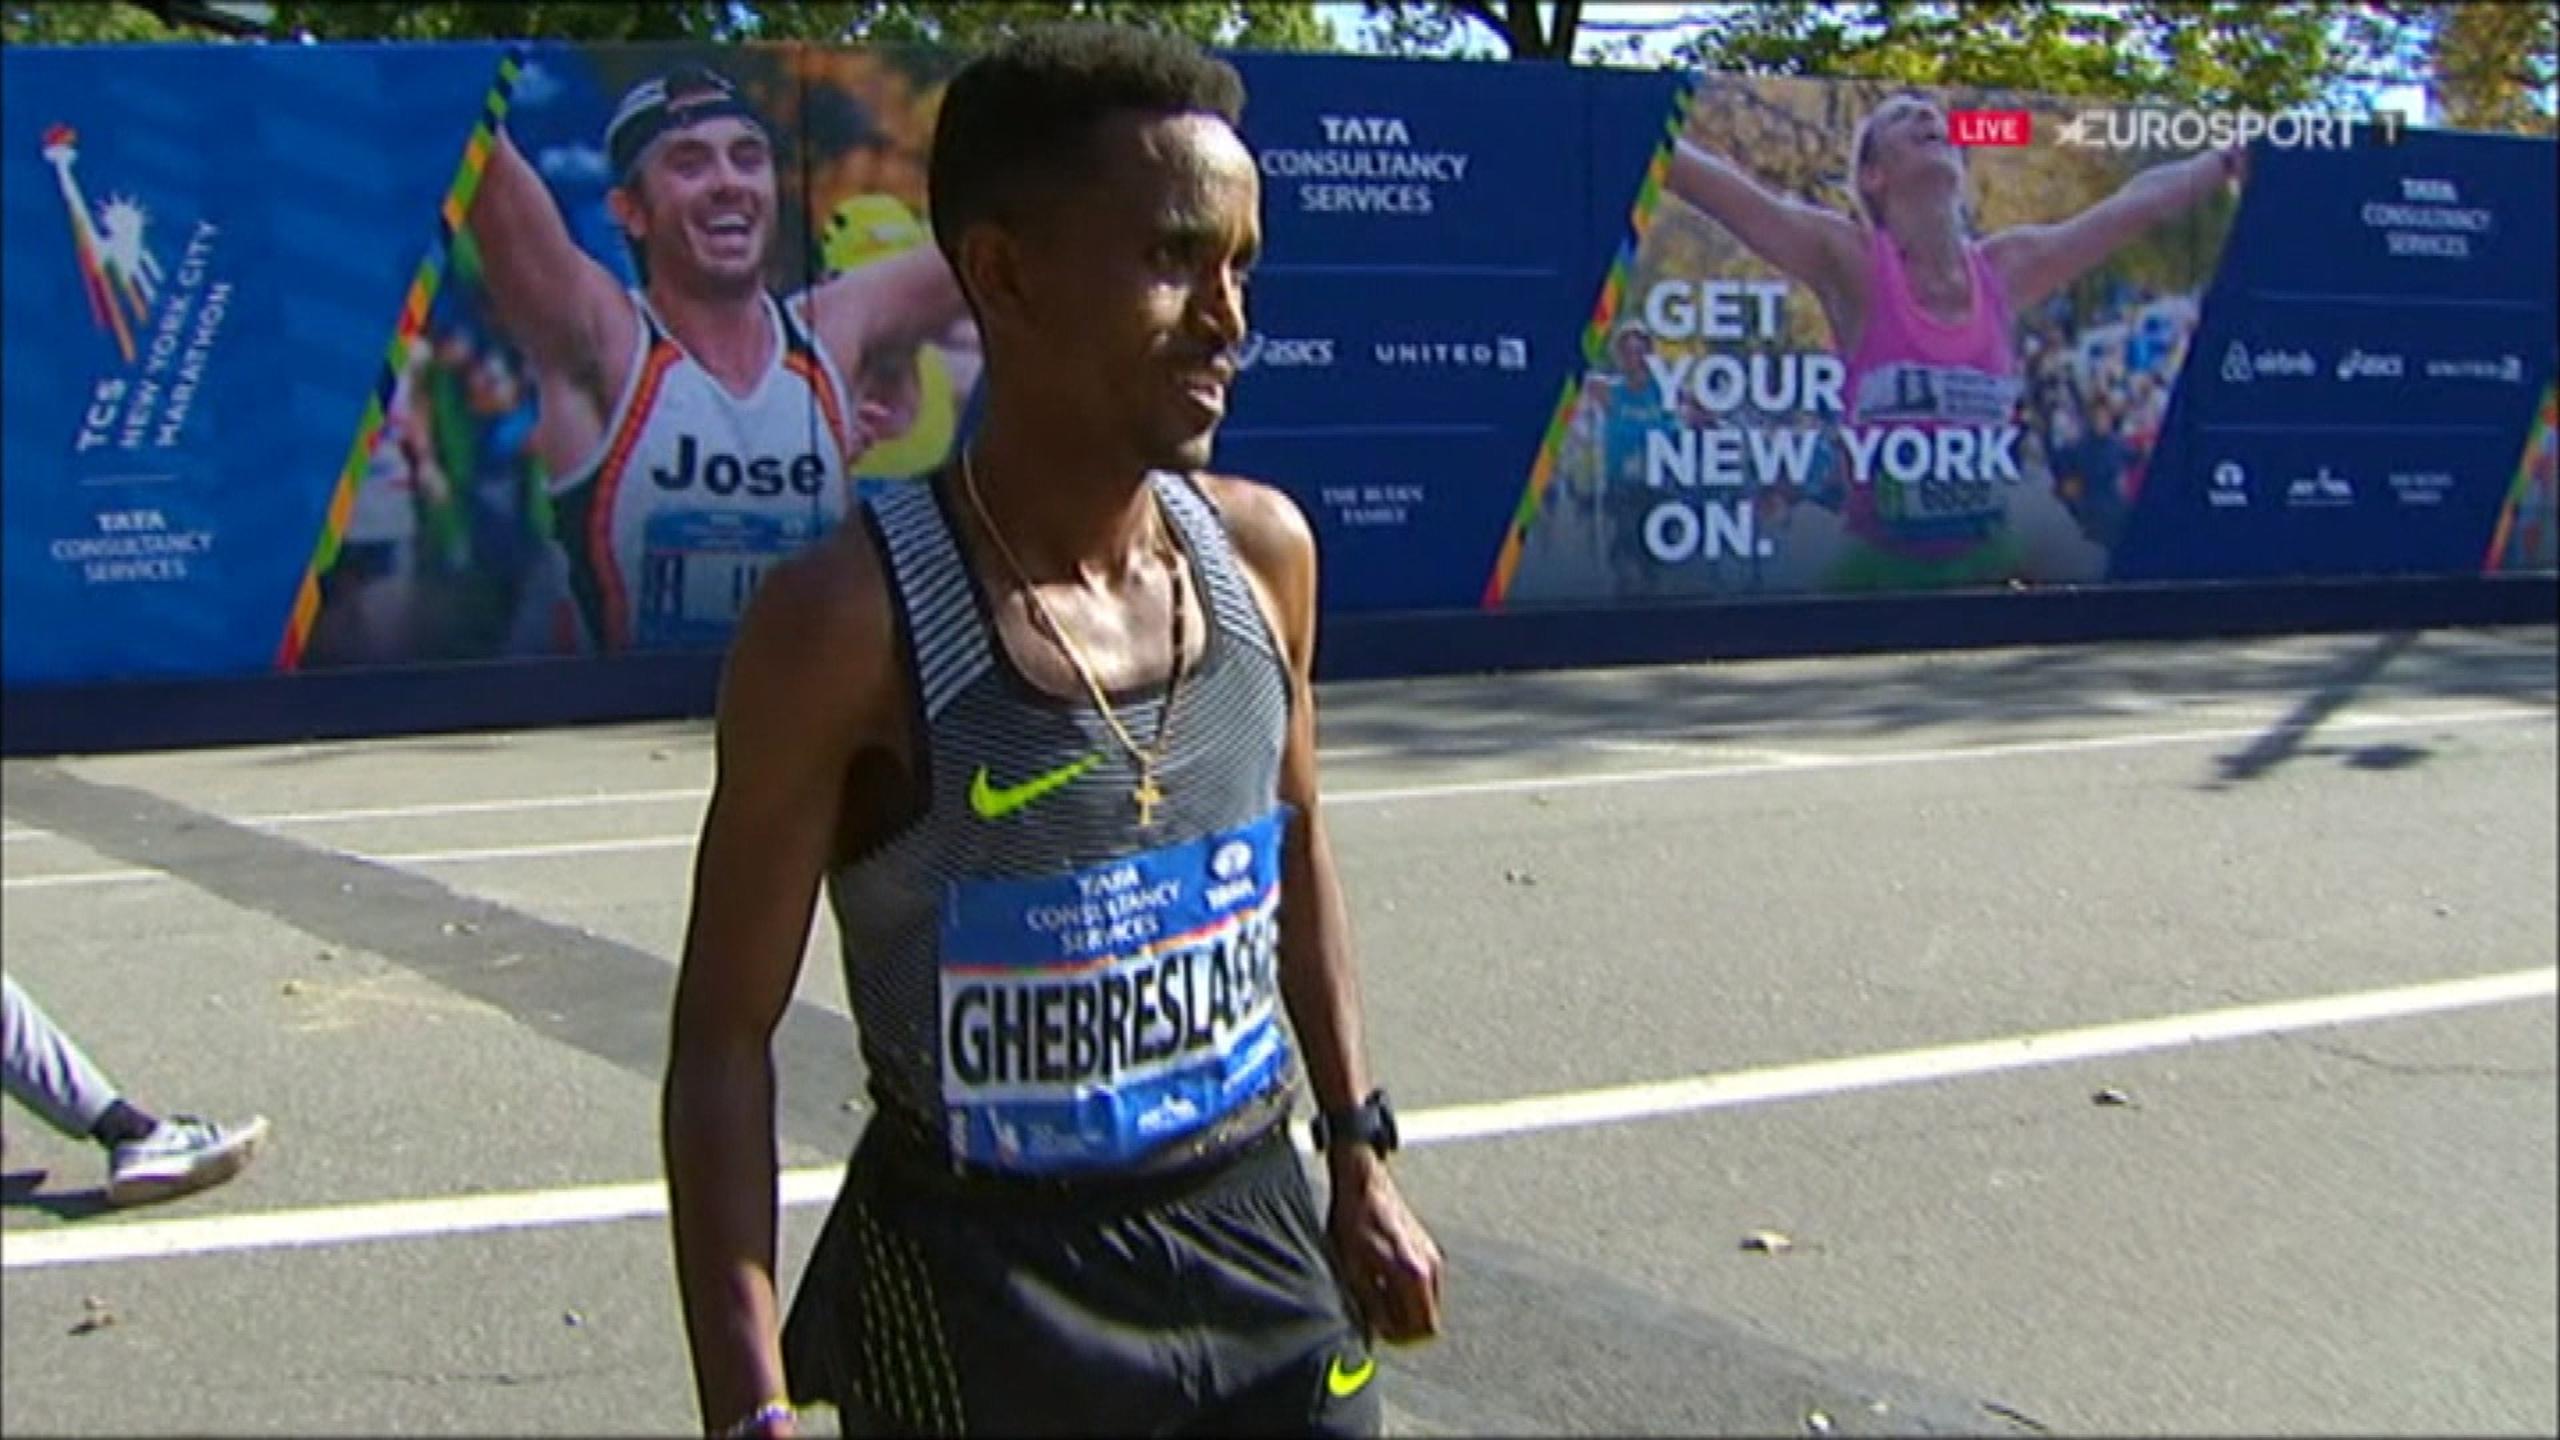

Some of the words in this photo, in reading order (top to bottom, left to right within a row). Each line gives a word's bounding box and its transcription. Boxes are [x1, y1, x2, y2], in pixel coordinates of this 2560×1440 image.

[1319, 115, 1410, 145] TATA
[1260, 150, 1468, 181] CONSULTANCY
[1300, 184, 1433, 213] SERVICES
[119, 379, 160, 447] NEW
[147, 294, 192, 373] YORK
[176, 218, 219, 287] CITY
[1644, 280, 1788, 339] GET
[154, 281, 233, 446] MARATHON
[1374, 342, 1492, 364] UNITED
[1645, 353, 1847, 412] YOUR
[76, 378, 126, 452] TCS
[652, 433, 826, 497] Jose
[1645, 426, 1820, 486] NEW
[1840, 424, 2022, 482] YORK
[51, 533, 212, 561] CONSULTANCY
[97, 509, 166, 532] TATA
[1644, 501, 1773, 562] ON.
[84, 558, 188, 583] SERVICES
